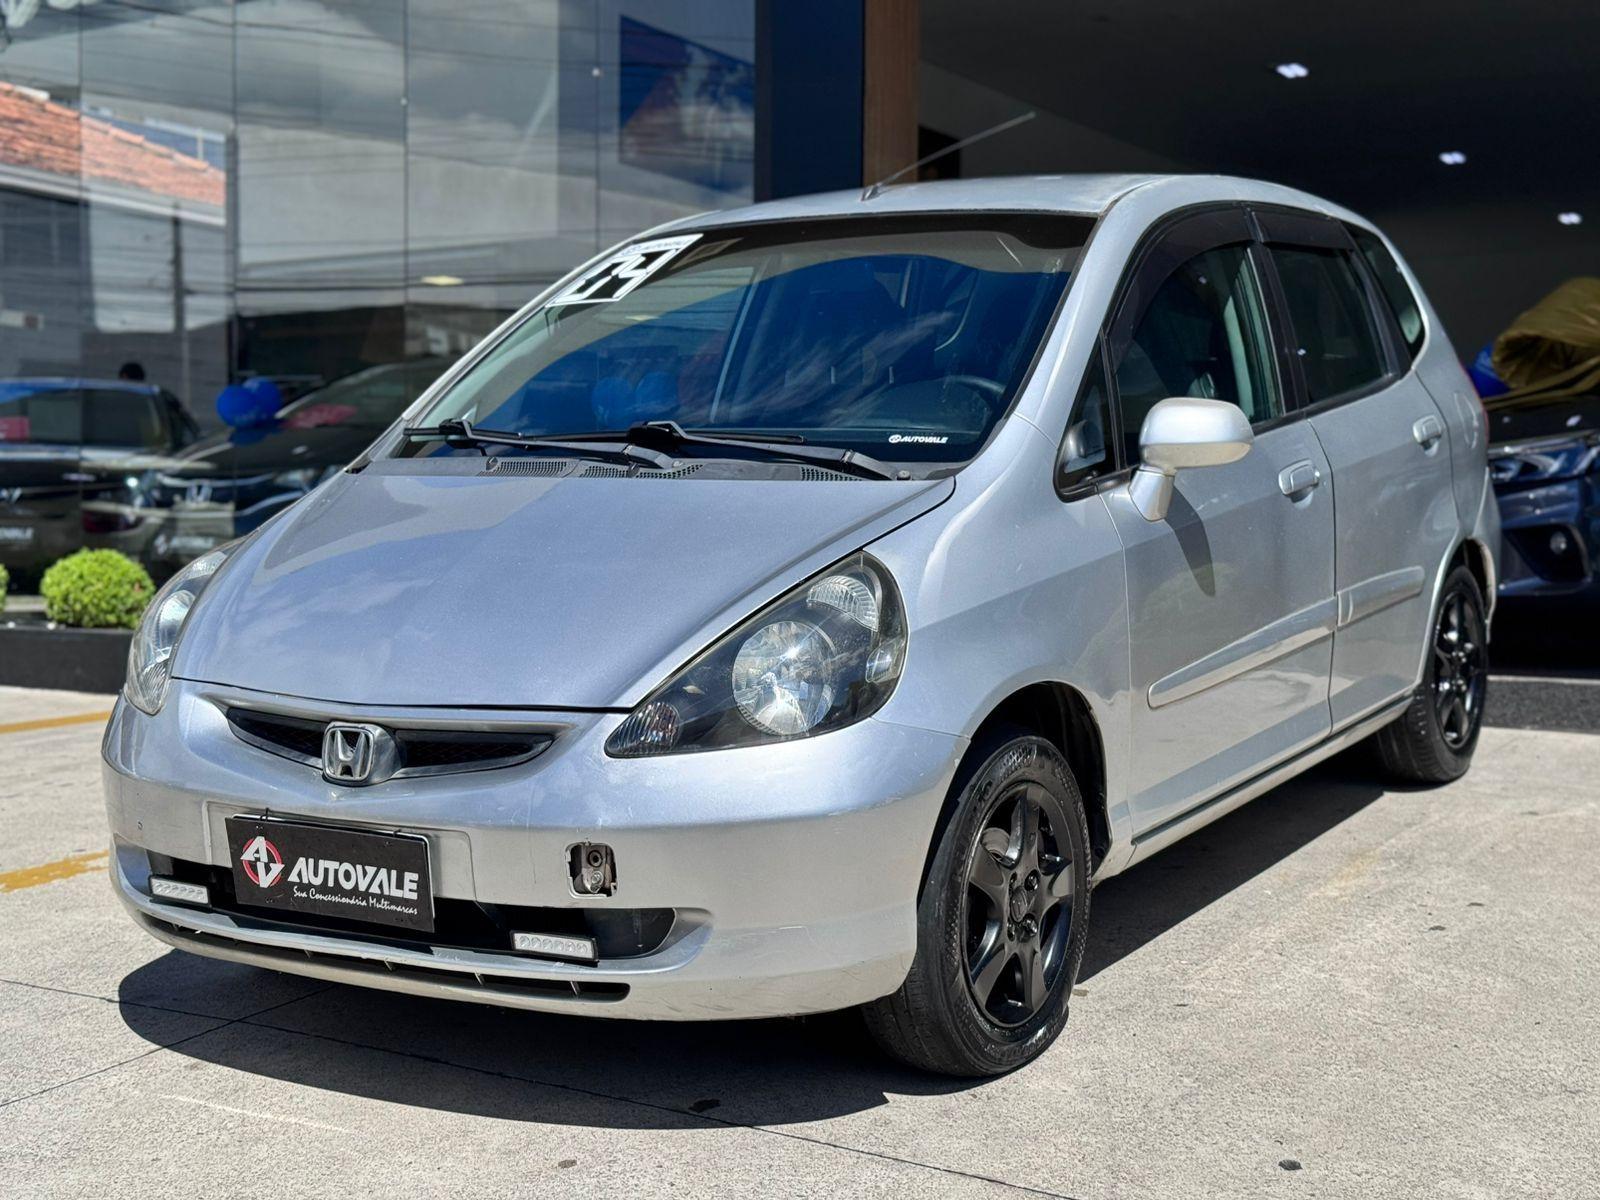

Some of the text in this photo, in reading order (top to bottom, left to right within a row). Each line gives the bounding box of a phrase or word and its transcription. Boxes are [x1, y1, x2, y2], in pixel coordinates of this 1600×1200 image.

[900, 434, 949, 444] AUTOVALE
[287, 856, 419, 900] AUTOVALE
[293, 885, 418, 915] Sua Concessionária Multimarcas
